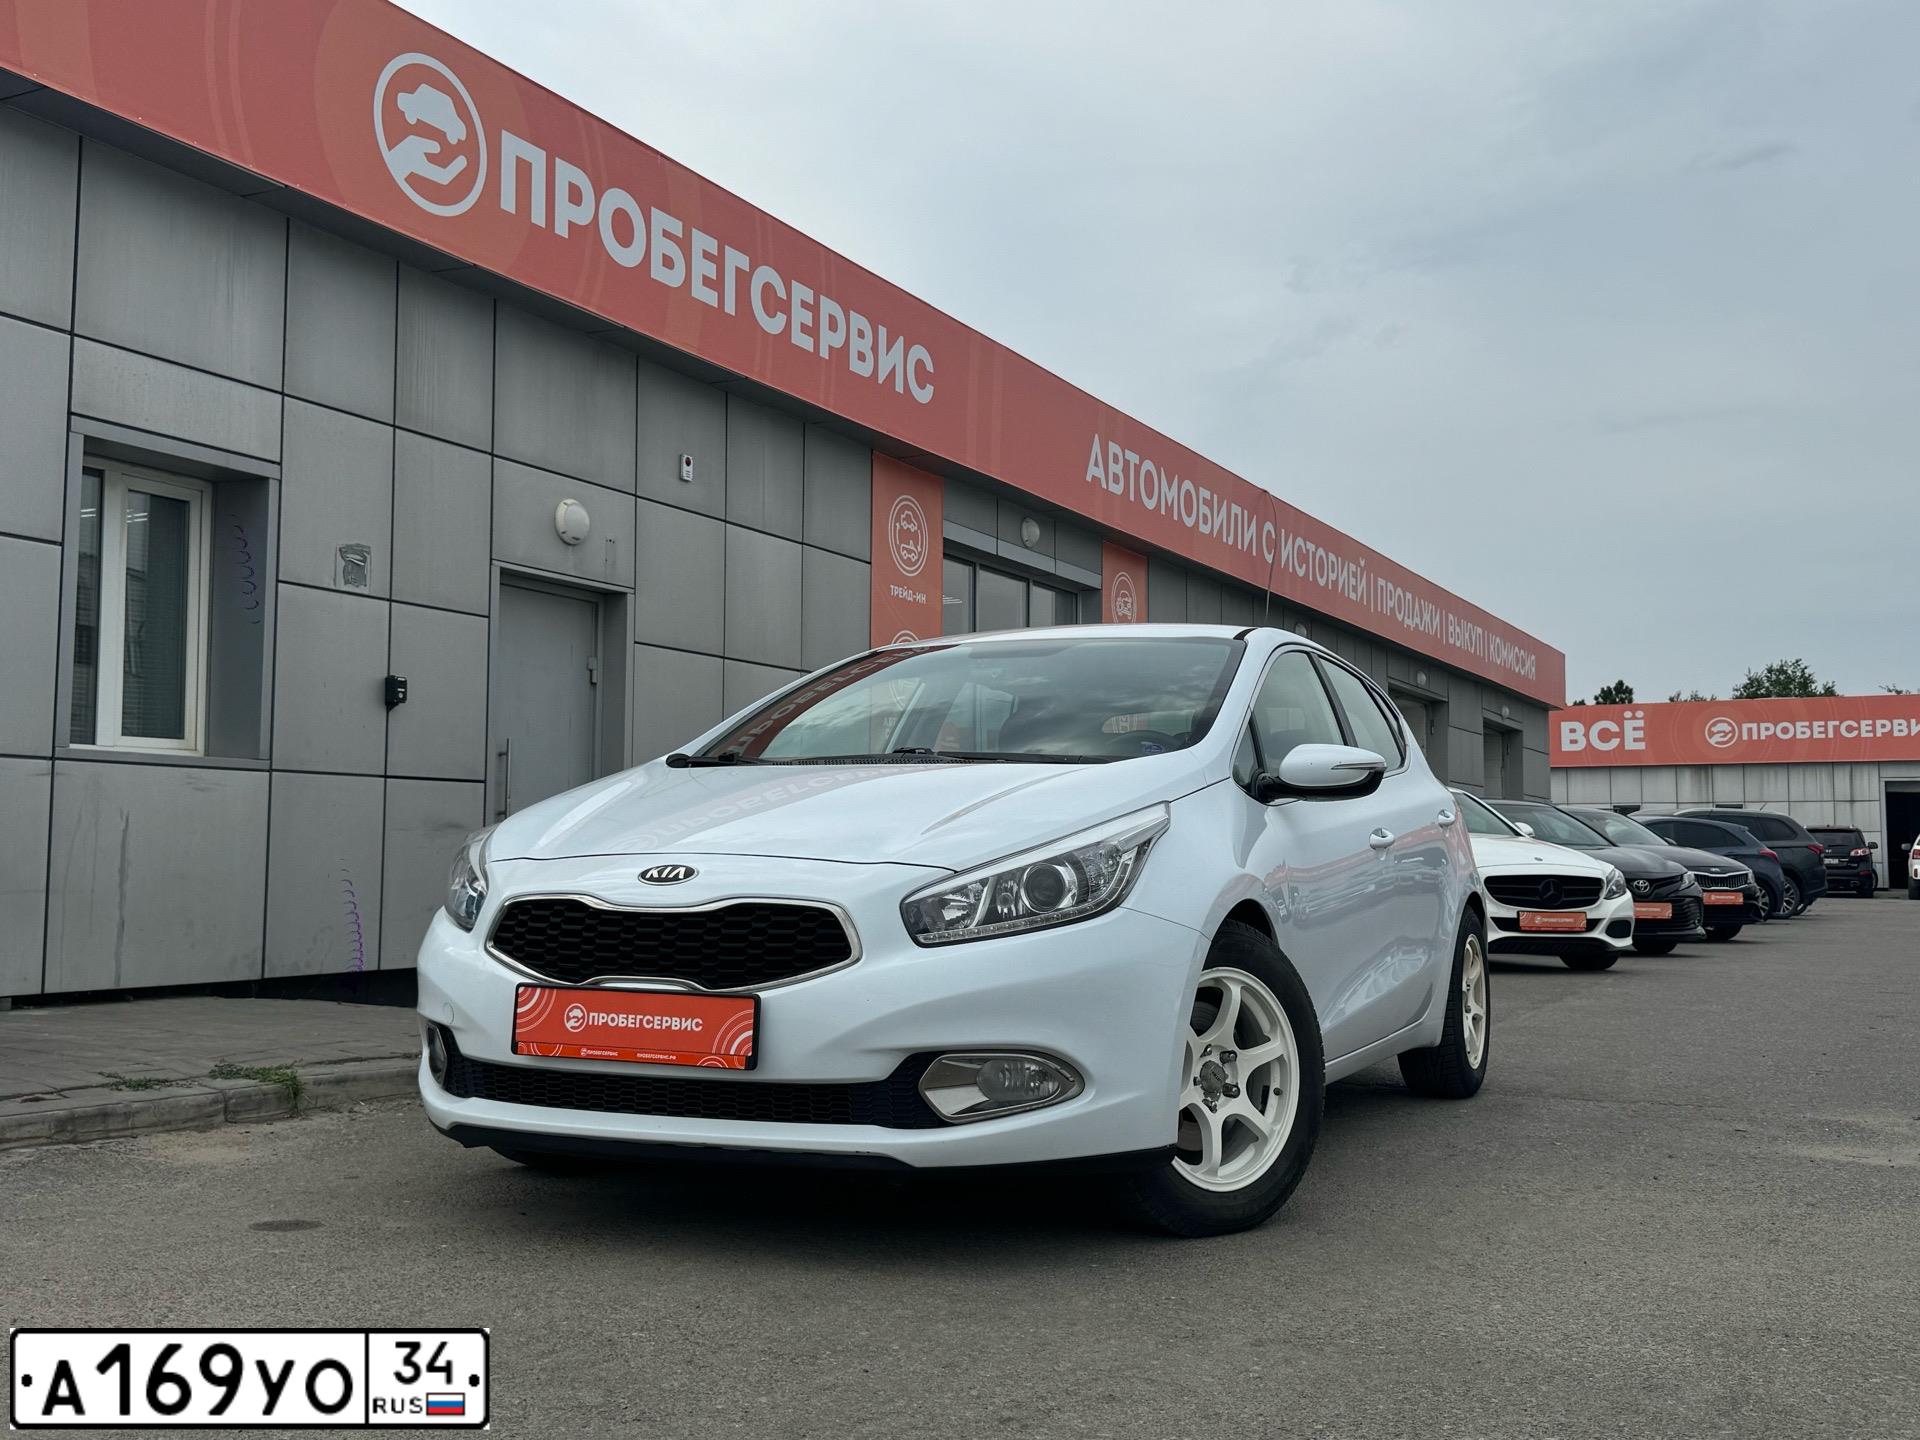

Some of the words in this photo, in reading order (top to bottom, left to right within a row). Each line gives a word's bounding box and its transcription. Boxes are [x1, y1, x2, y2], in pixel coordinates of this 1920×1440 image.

[500, 129, 934, 404] ПРОБЕГСЕРВИС
[1086, 433, 1256, 556] АВТОМОБИЛИ
[1262, 521, 1275, 564] С
[1281, 528, 1367, 605] ИСТОРИЕЙ
[1377, 577, 1440, 638] ПРОДАЖИ
[1448, 613, 1483, 658] ВЫКУП
[1489, 633, 1536, 680] КОМИССИЯ
[889, 584, 927, 605] ТРЕЙД-ИН
[1561, 710, 1646, 752] ВСЁ
[645, 866, 686, 879] KIA
[588, 1012, 703, 1031] ПРОБЕГСЕРВИС
